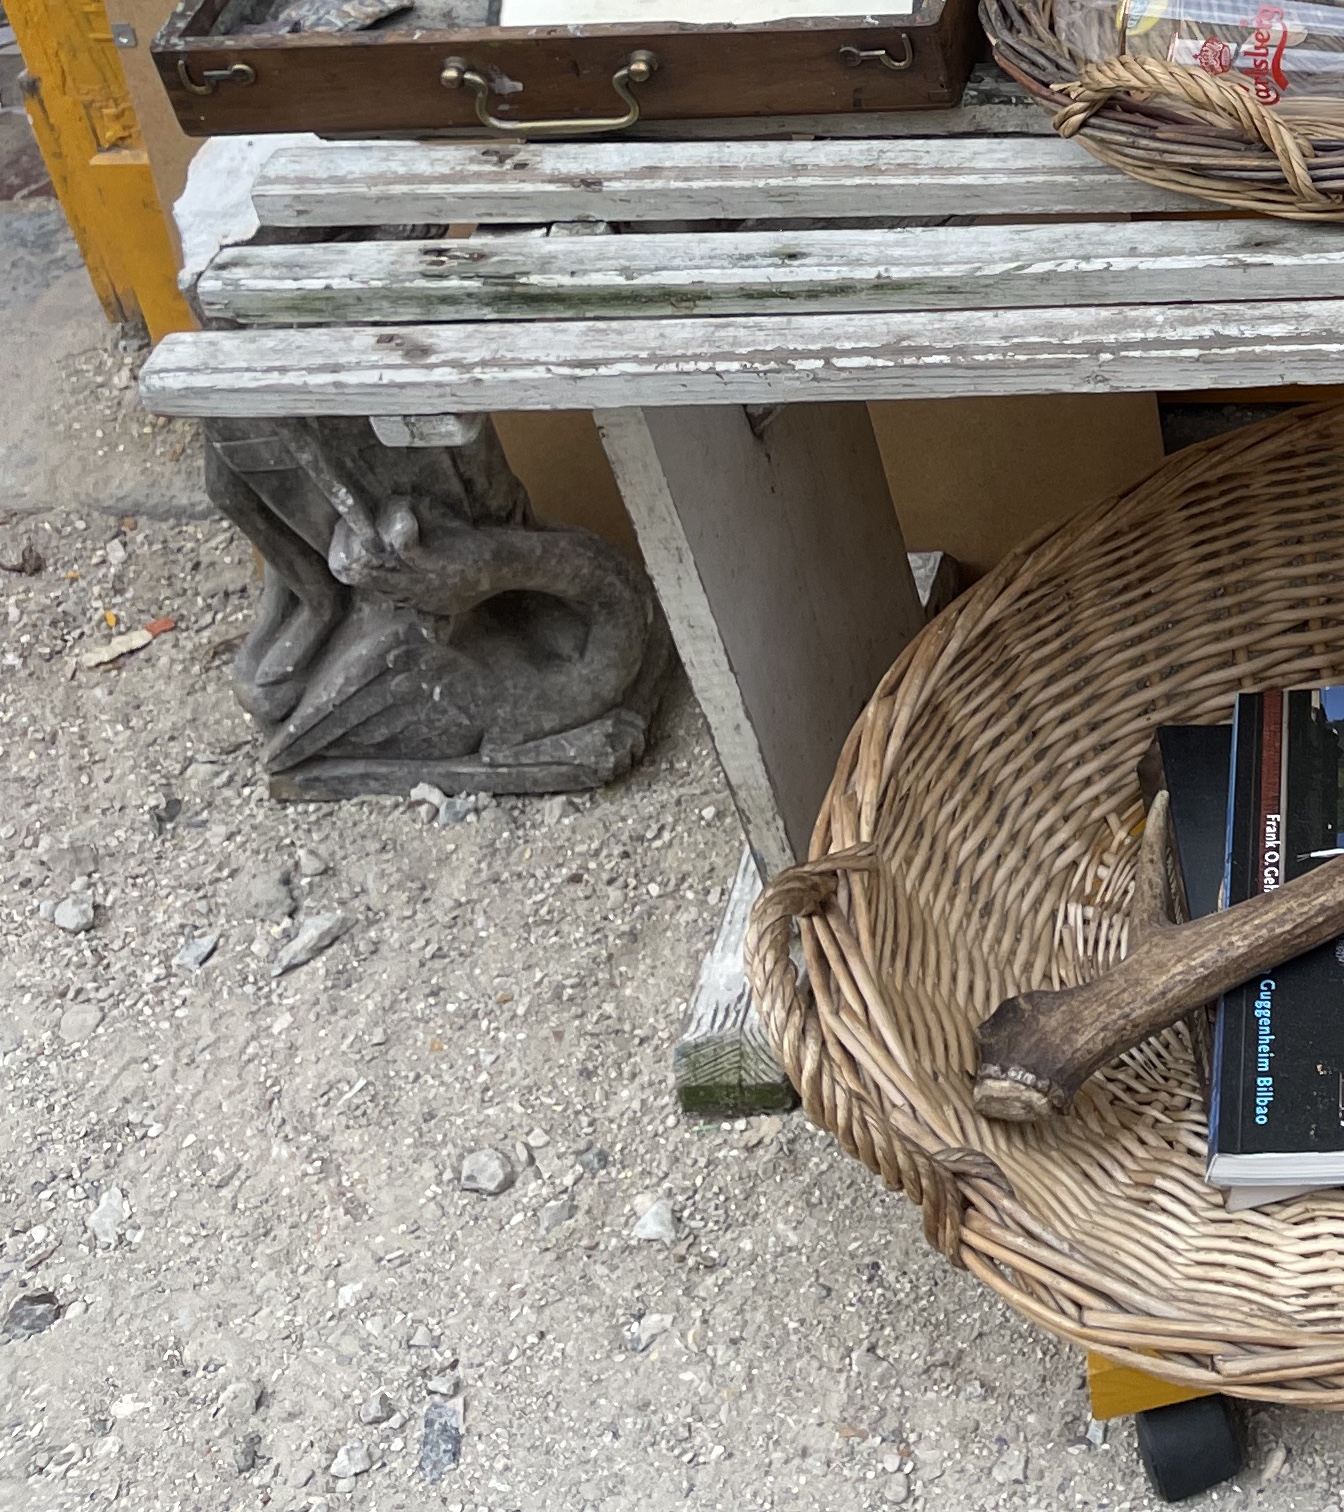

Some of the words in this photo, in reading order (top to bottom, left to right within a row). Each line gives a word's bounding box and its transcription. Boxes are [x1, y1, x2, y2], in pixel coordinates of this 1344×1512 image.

[1265, 813, 1281, 847] Frank
[1264, 850, 1280, 868] O.
[1253, 979, 1276, 1073] Guggenheim
[1254, 1076, 1274, 1126] Bilbao
